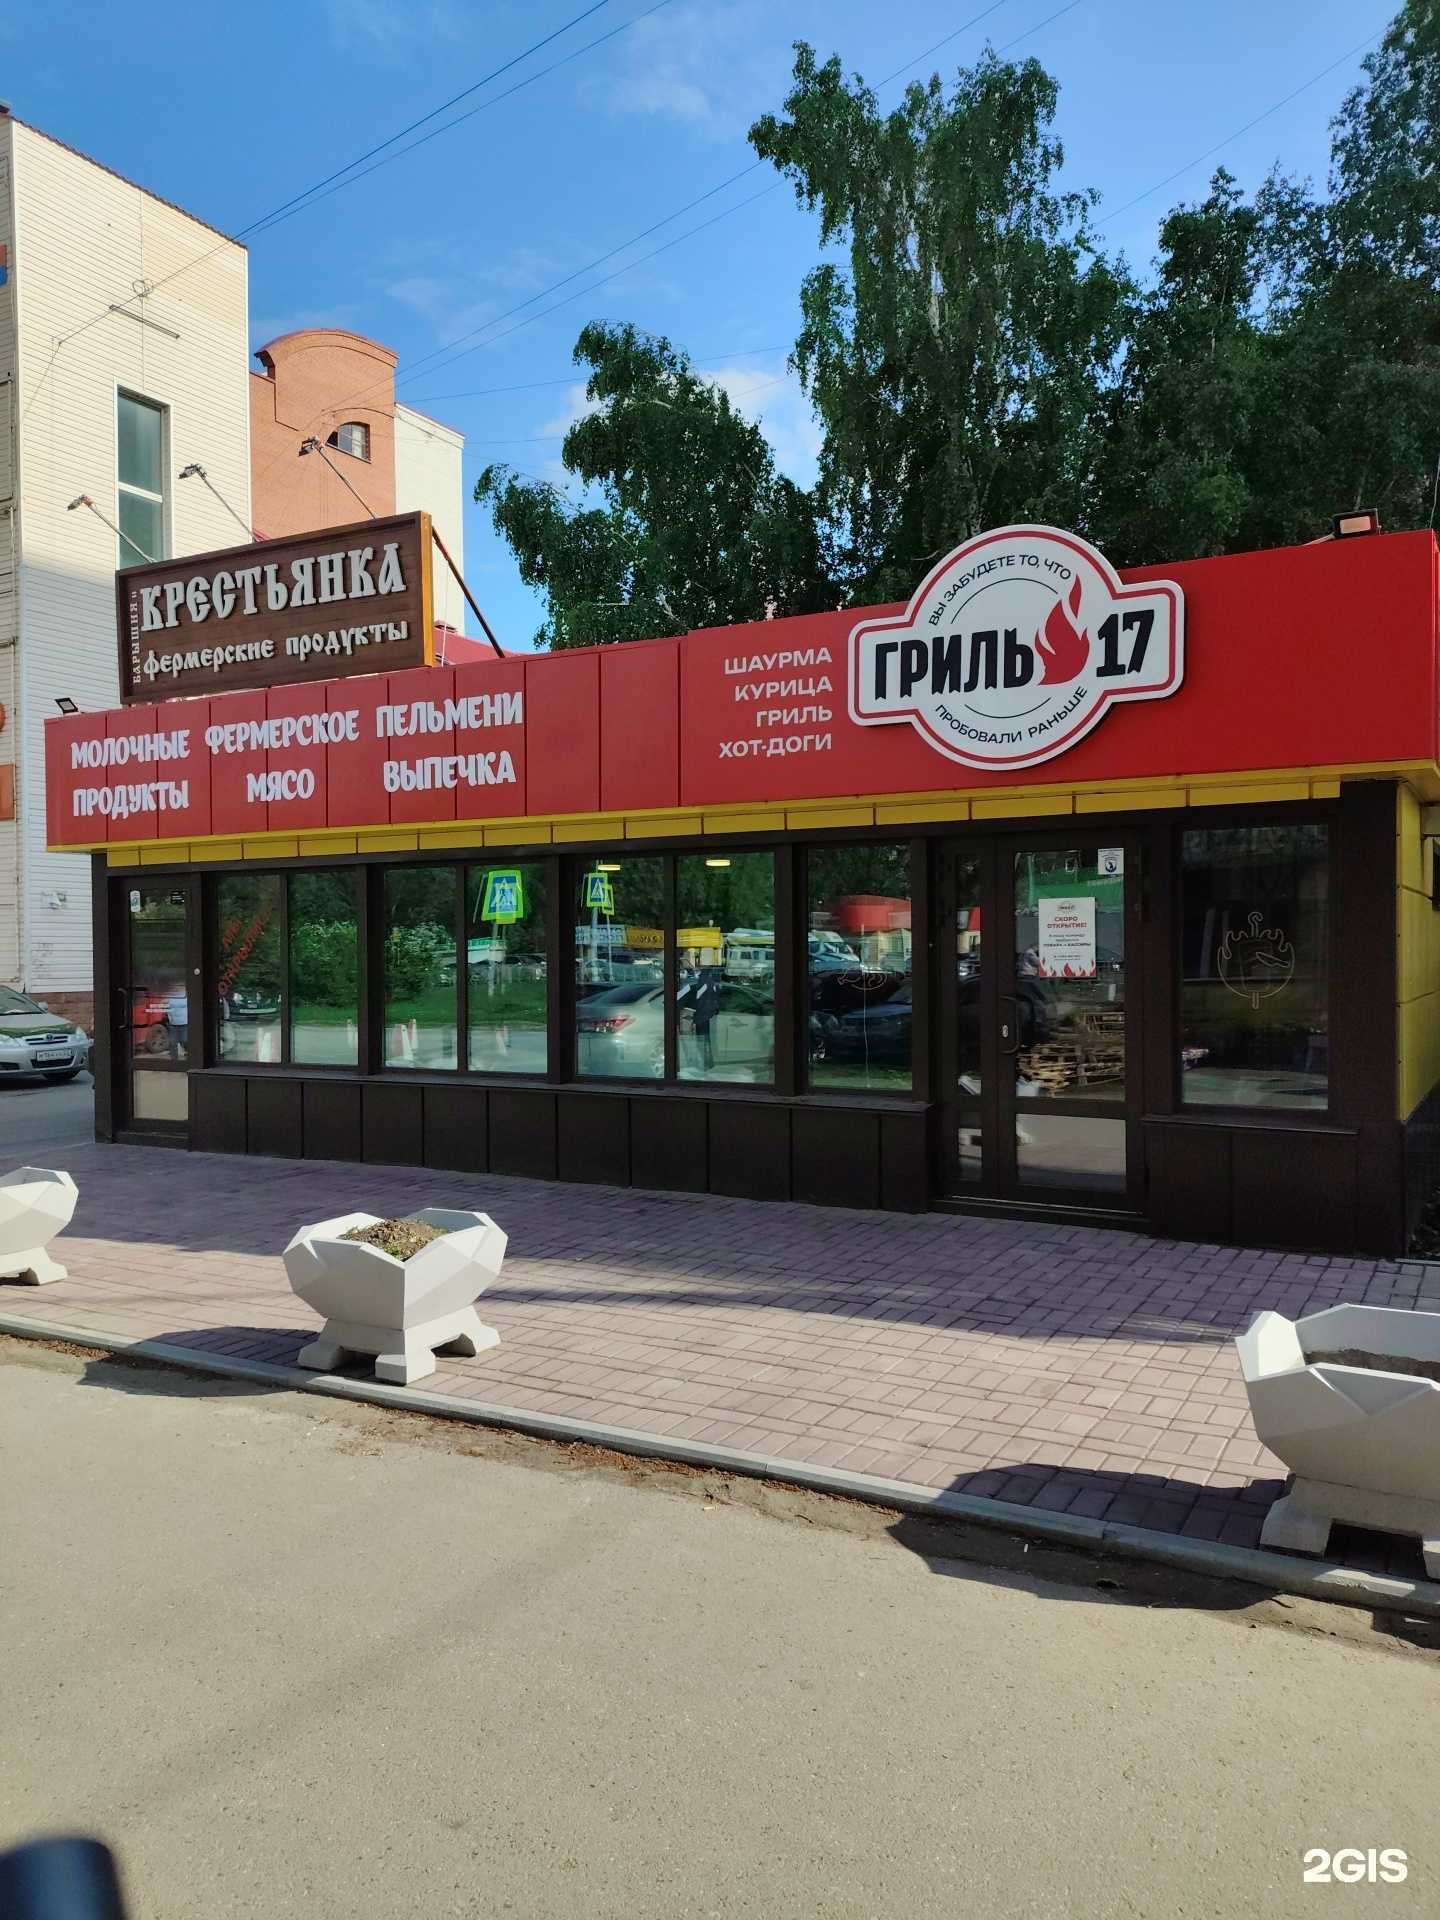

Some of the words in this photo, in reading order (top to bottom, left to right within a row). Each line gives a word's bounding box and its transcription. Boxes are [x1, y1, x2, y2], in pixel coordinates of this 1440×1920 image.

[140, 543, 407, 632] КРЕСТЬЯНКА
[928, 601, 947, 627] ВЫ
[944, 554, 1016, 603] ЗАБУДЕТЕ
[1019, 554, 1040, 568] ТО,
[1044, 560, 1072, 581] ЧТО
[144, 639, 275, 681] фермерские
[286, 621, 408, 661] продукты
[724, 646, 833, 675] ШАУРМА
[875, 627, 1035, 701] ГРИЛЬ
[1096, 608, 1155, 678] 17
[735, 675, 833, 702] КУРИЦА
[205, 709, 361, 755] ФЕРМЕРСКОЕ
[376, 691, 523, 738] ПЕЛЬМЕНИ
[756, 705, 833, 728] ГРИЛЬ
[935, 703, 1023, 744] ПРОБОВАЛИ
[1028, 685, 1088, 738] РАНЬШЕ
[71, 729, 191, 769] МОЛОЧНЫЕ
[719, 733, 832, 759] ХОТ-ДОГИ
[246, 768, 316, 802] МЯСО
[383, 750, 517, 793] ВЫПЕЧКА
[73, 780, 189, 820] ПРОДУКТЫ
